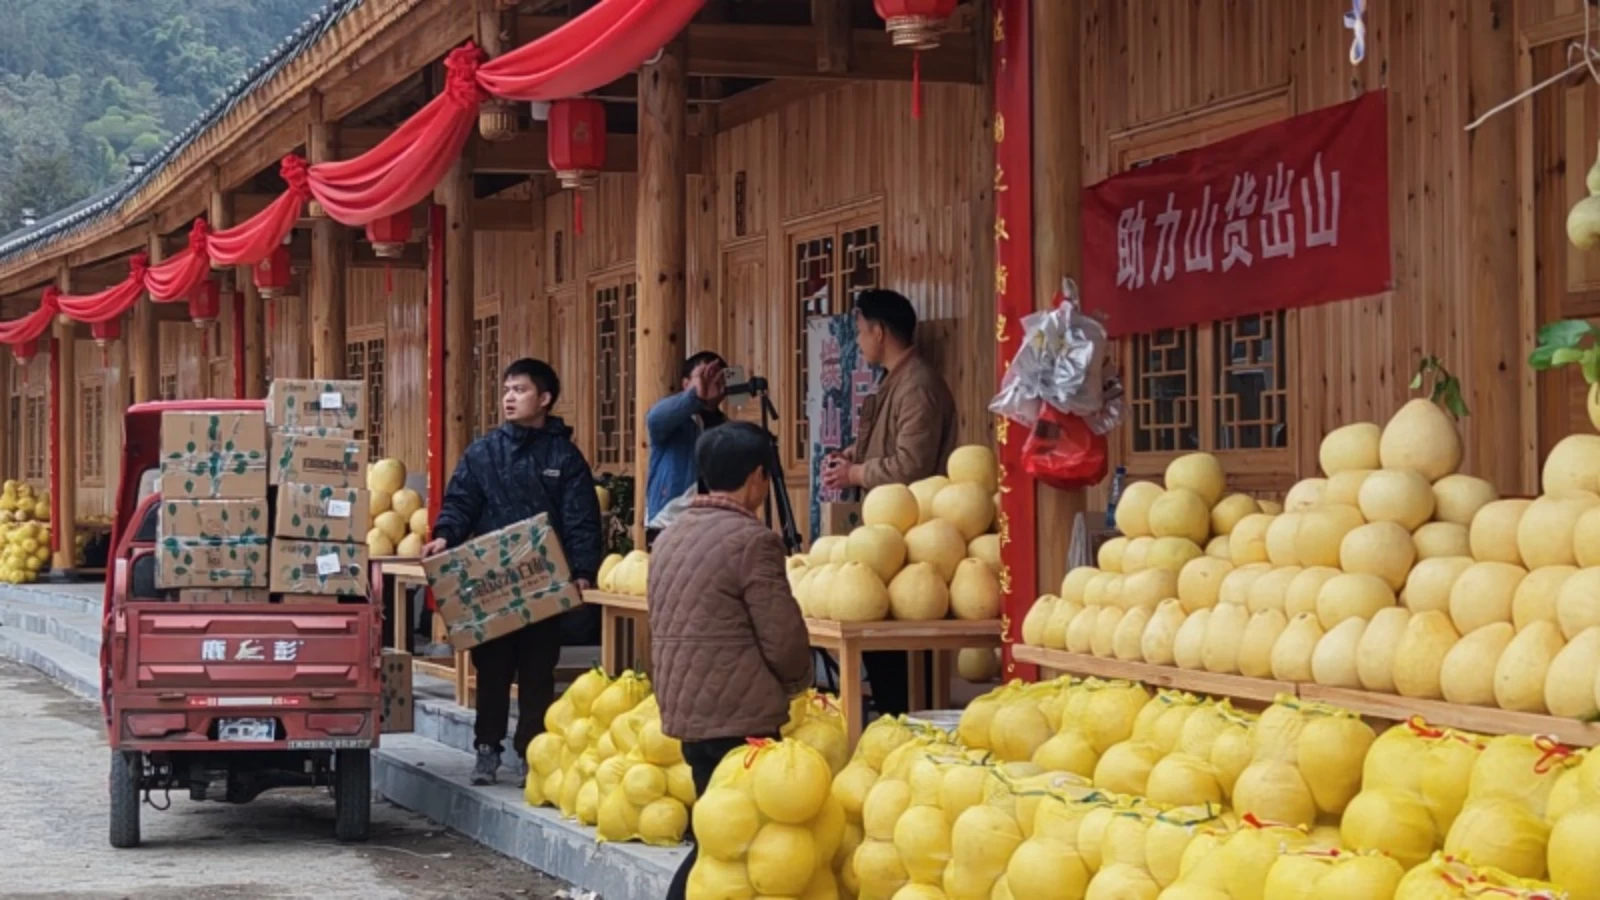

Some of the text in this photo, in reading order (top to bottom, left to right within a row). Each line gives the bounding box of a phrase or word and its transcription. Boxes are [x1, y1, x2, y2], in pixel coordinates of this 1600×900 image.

[1115, 151, 1341, 291] 助力山货出山
